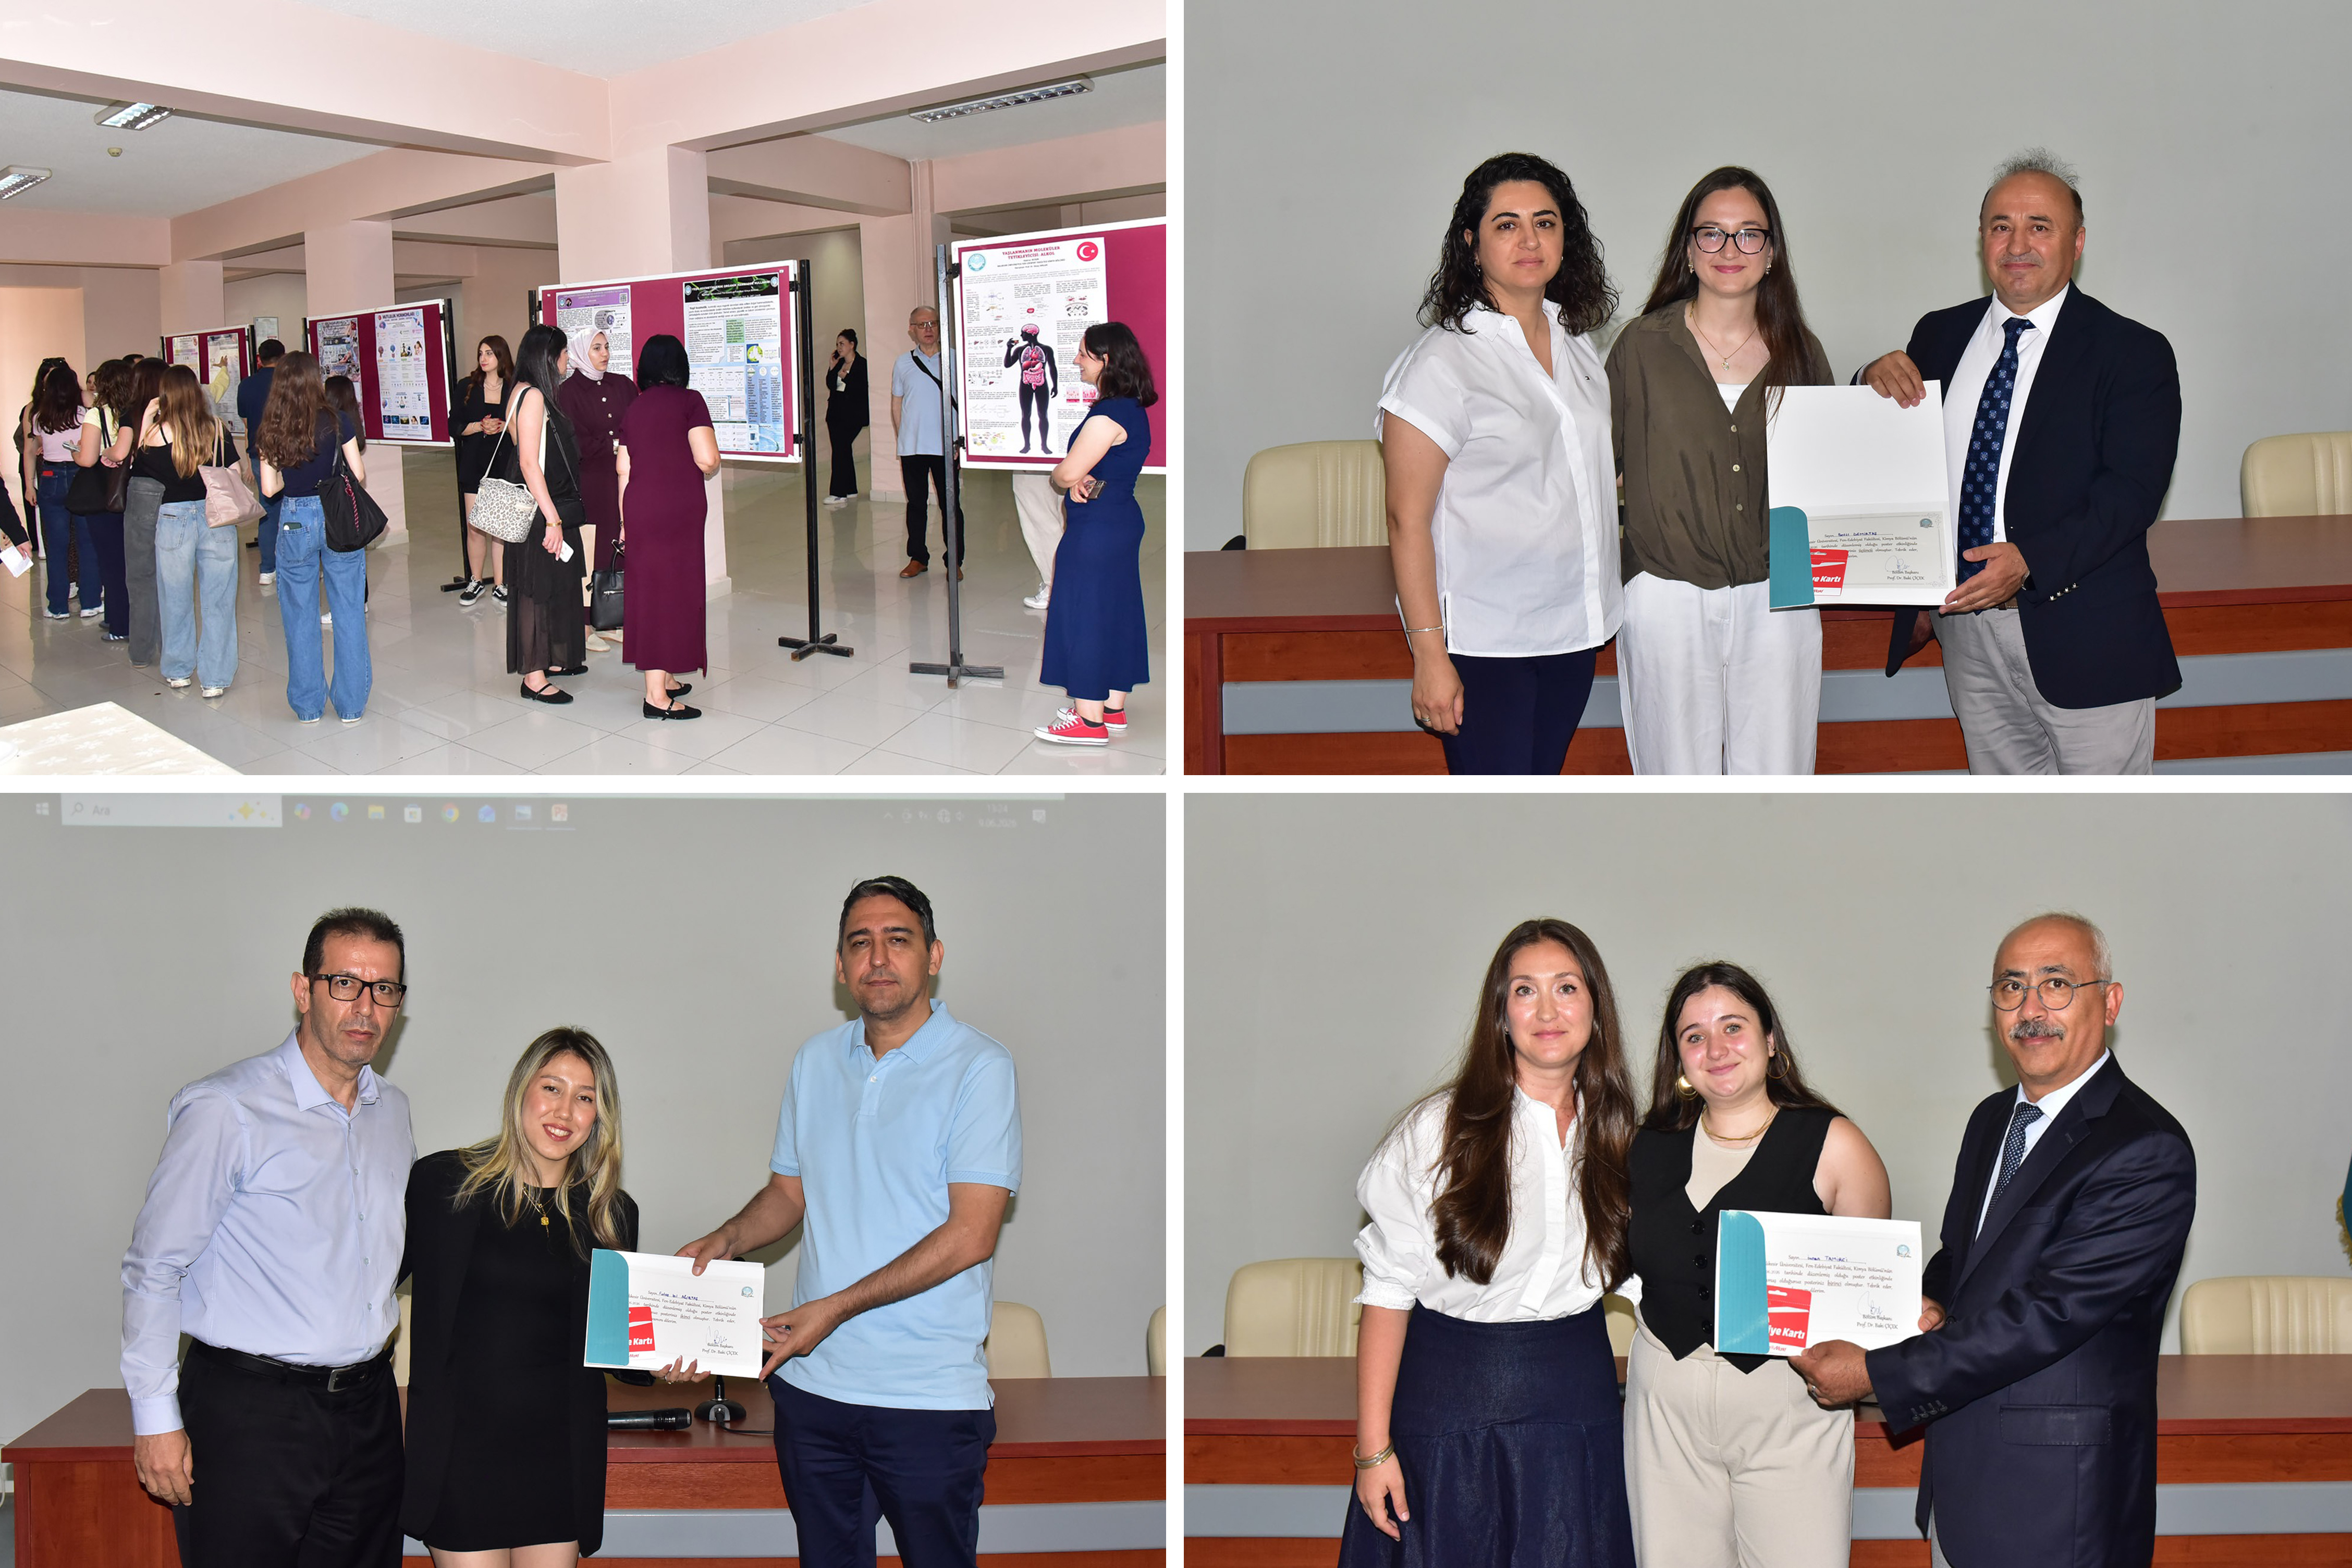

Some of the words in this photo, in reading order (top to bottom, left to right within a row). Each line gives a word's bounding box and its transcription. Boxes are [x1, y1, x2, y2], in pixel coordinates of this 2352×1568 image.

[92, 804, 111, 815] Ara
[1782, 1327, 1805, 1339] Kartı
[633, 1337, 653, 1345] Kartı
